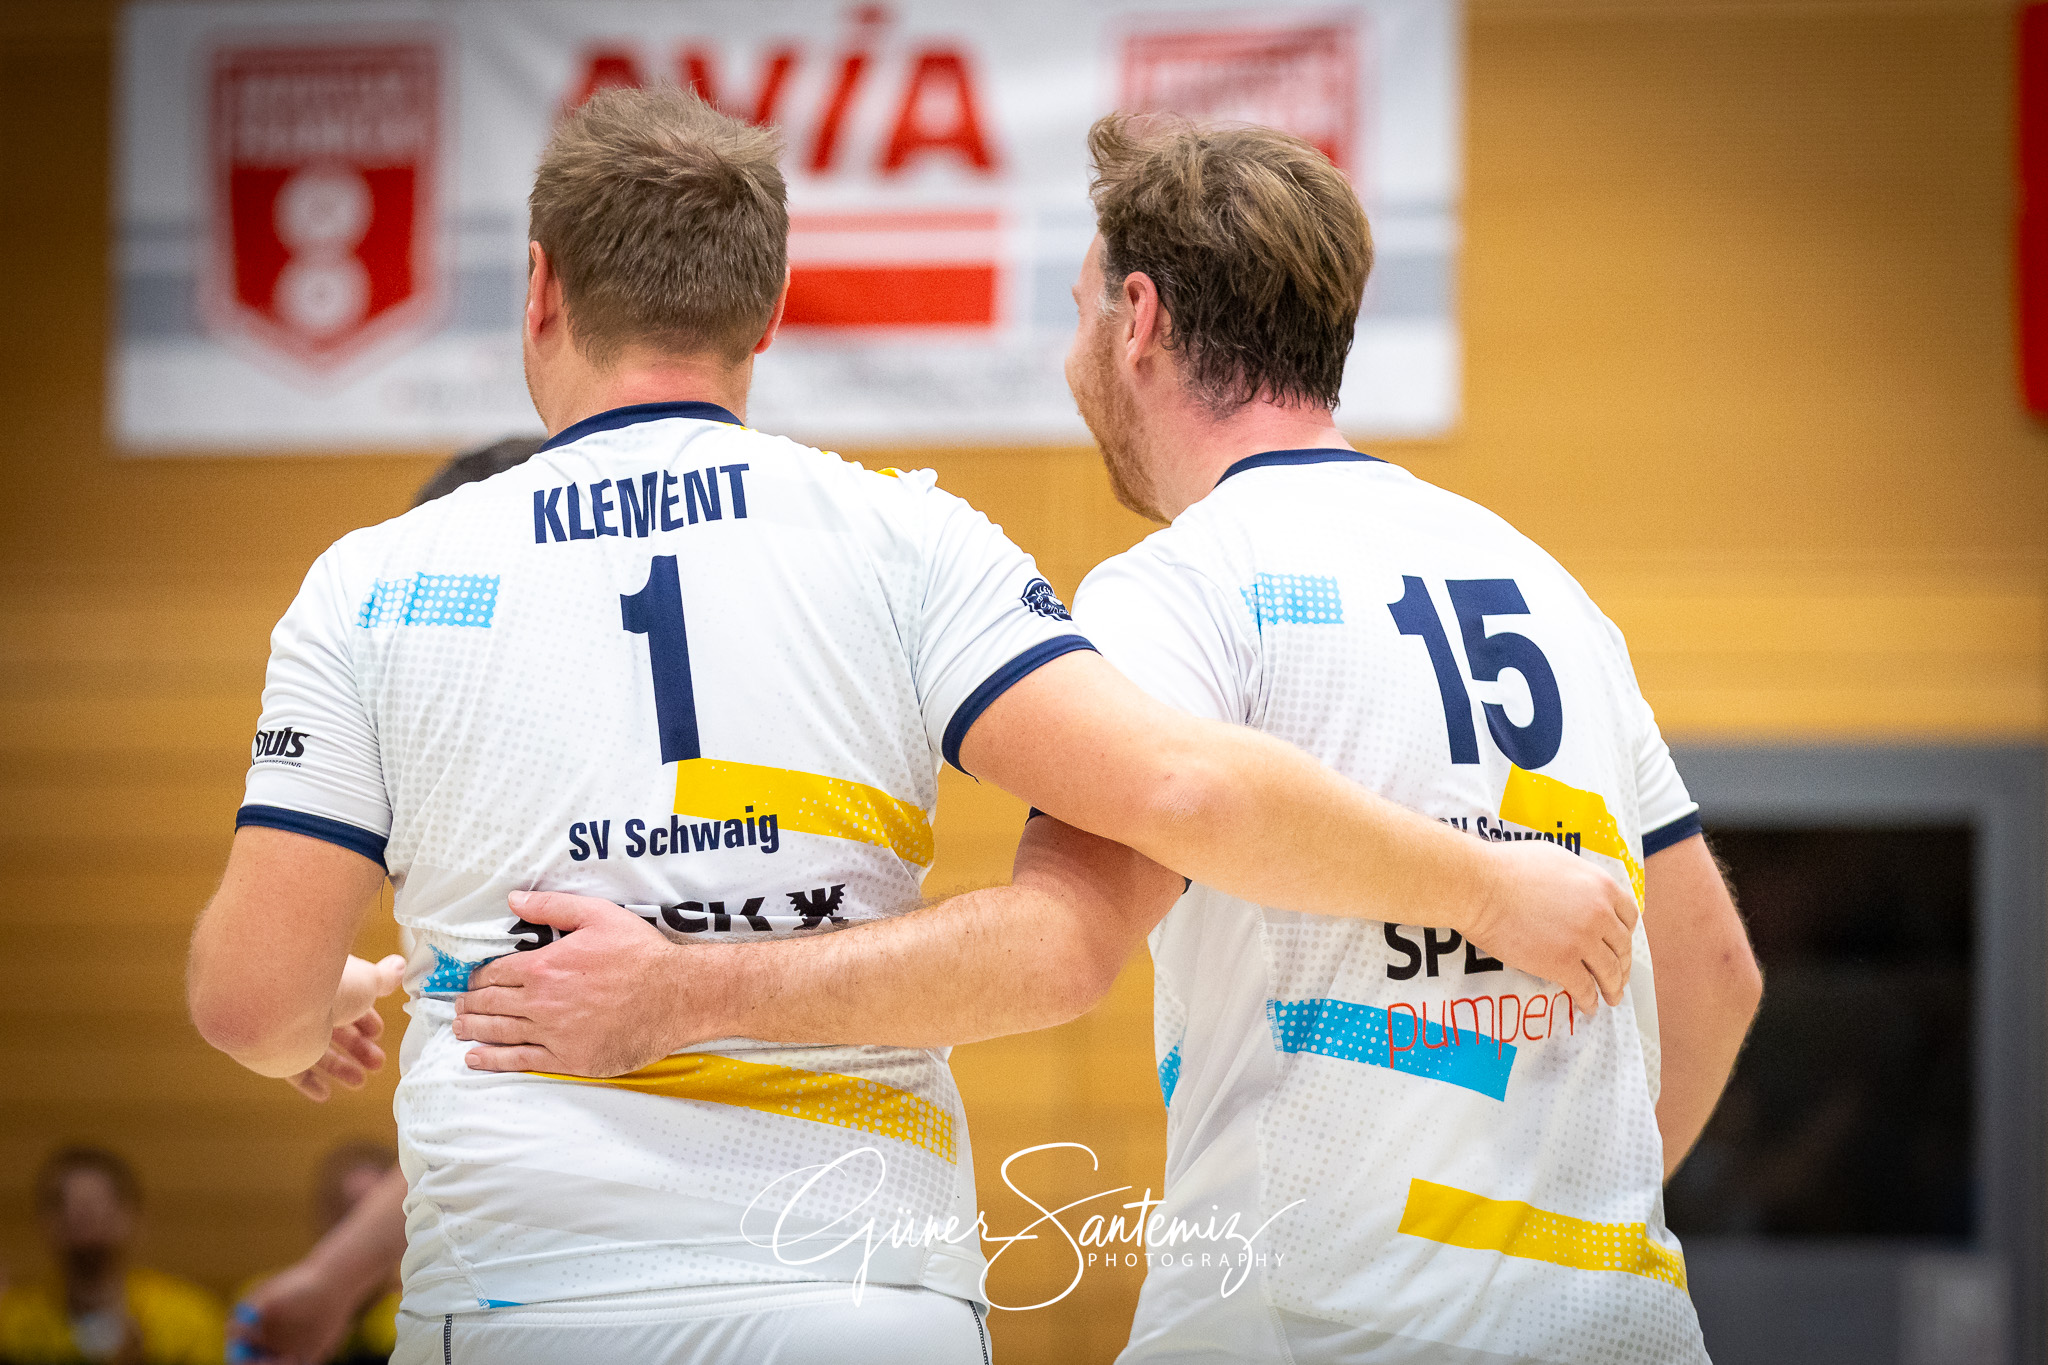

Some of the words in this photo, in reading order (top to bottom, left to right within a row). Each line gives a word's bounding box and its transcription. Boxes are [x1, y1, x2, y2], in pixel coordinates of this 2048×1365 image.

[533, 463, 750, 544] KLEMENT
[619, 554, 701, 765] 1
[1386, 574, 1563, 770] 15
[568, 819, 611, 862] SV
[624, 805, 780, 858] Schwaig
[1387, 989, 1574, 1069] pumpen
